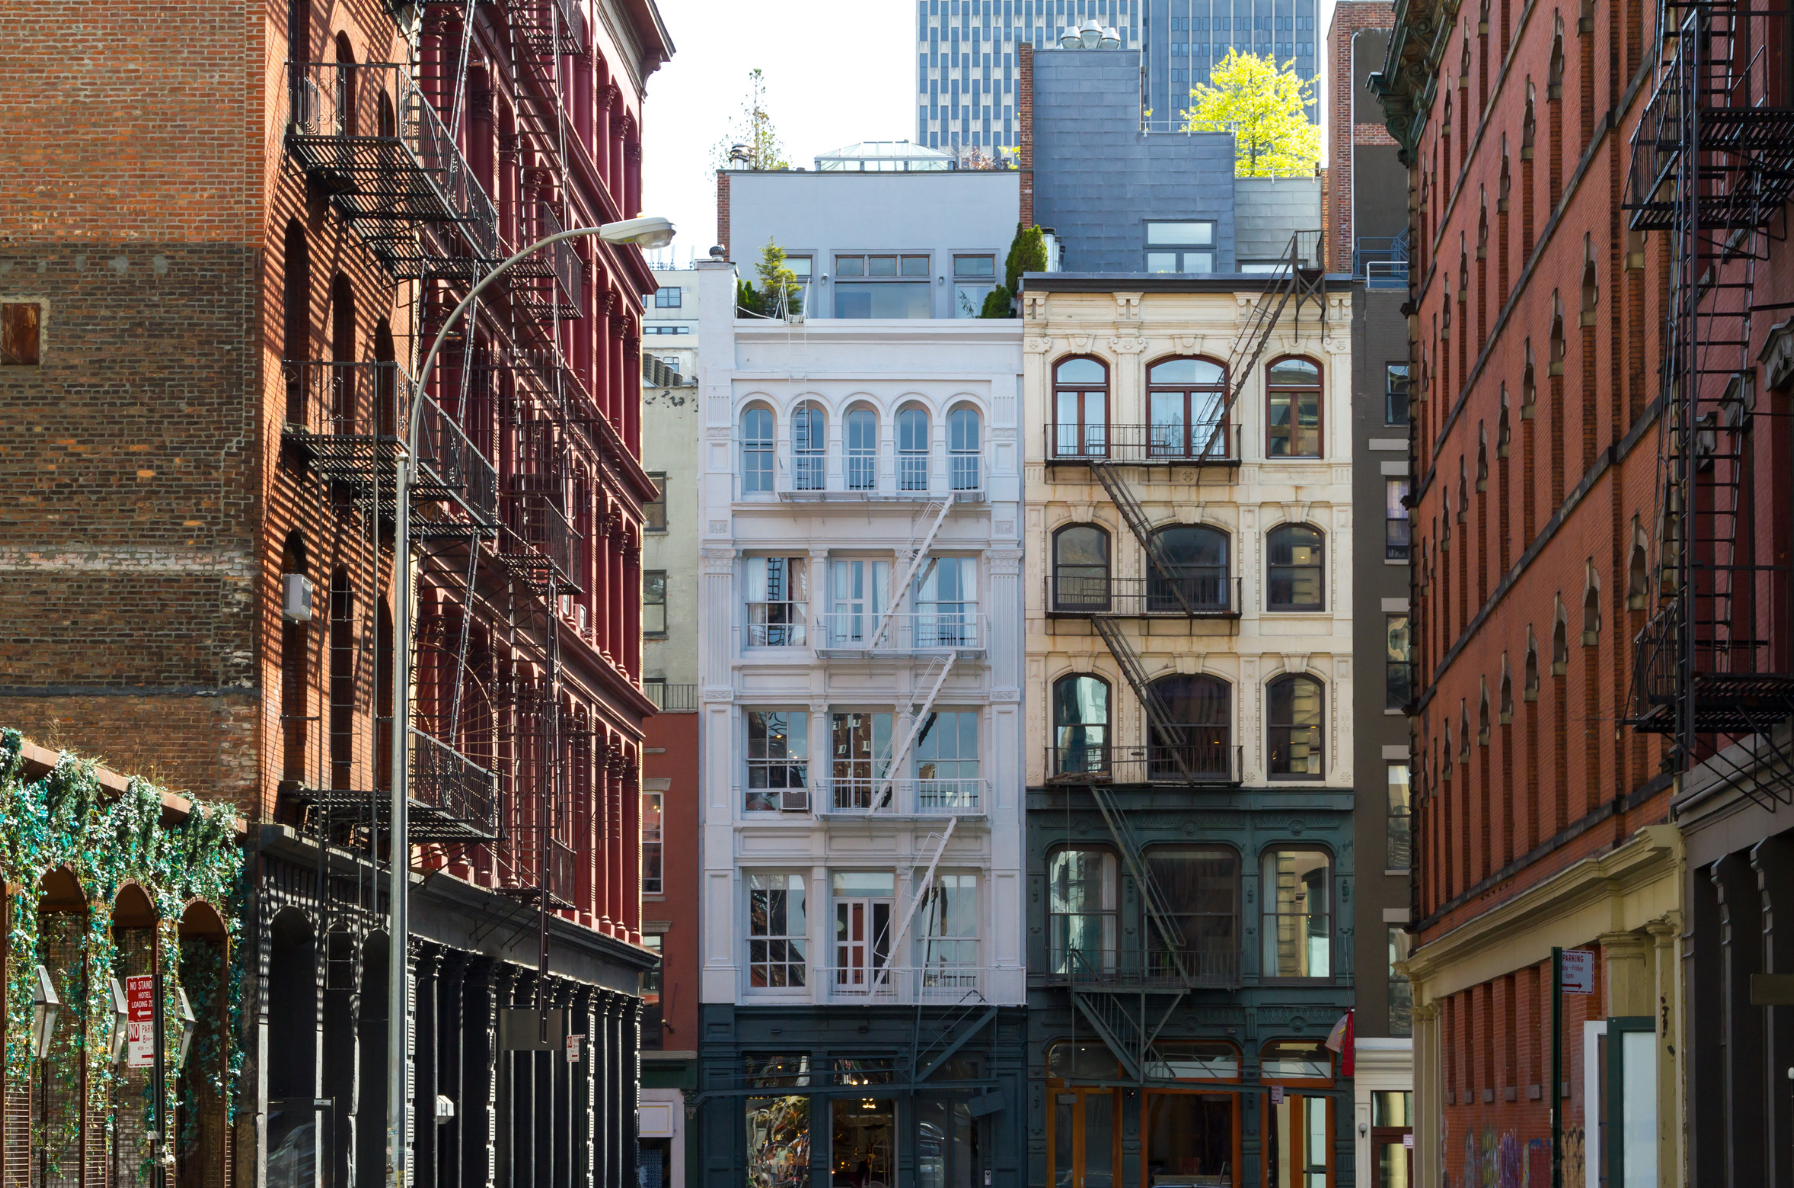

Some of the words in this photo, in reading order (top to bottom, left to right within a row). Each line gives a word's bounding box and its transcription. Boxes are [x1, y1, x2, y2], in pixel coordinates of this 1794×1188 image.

[1562, 954, 1584, 963] PARKING
[1572, 965, 1584, 973] Friday
[130, 981, 136, 990] NO
[138, 991, 151, 999] HOTEL
[131, 1000, 147, 1008] LOADING
[130, 1024, 138, 1038] NO
